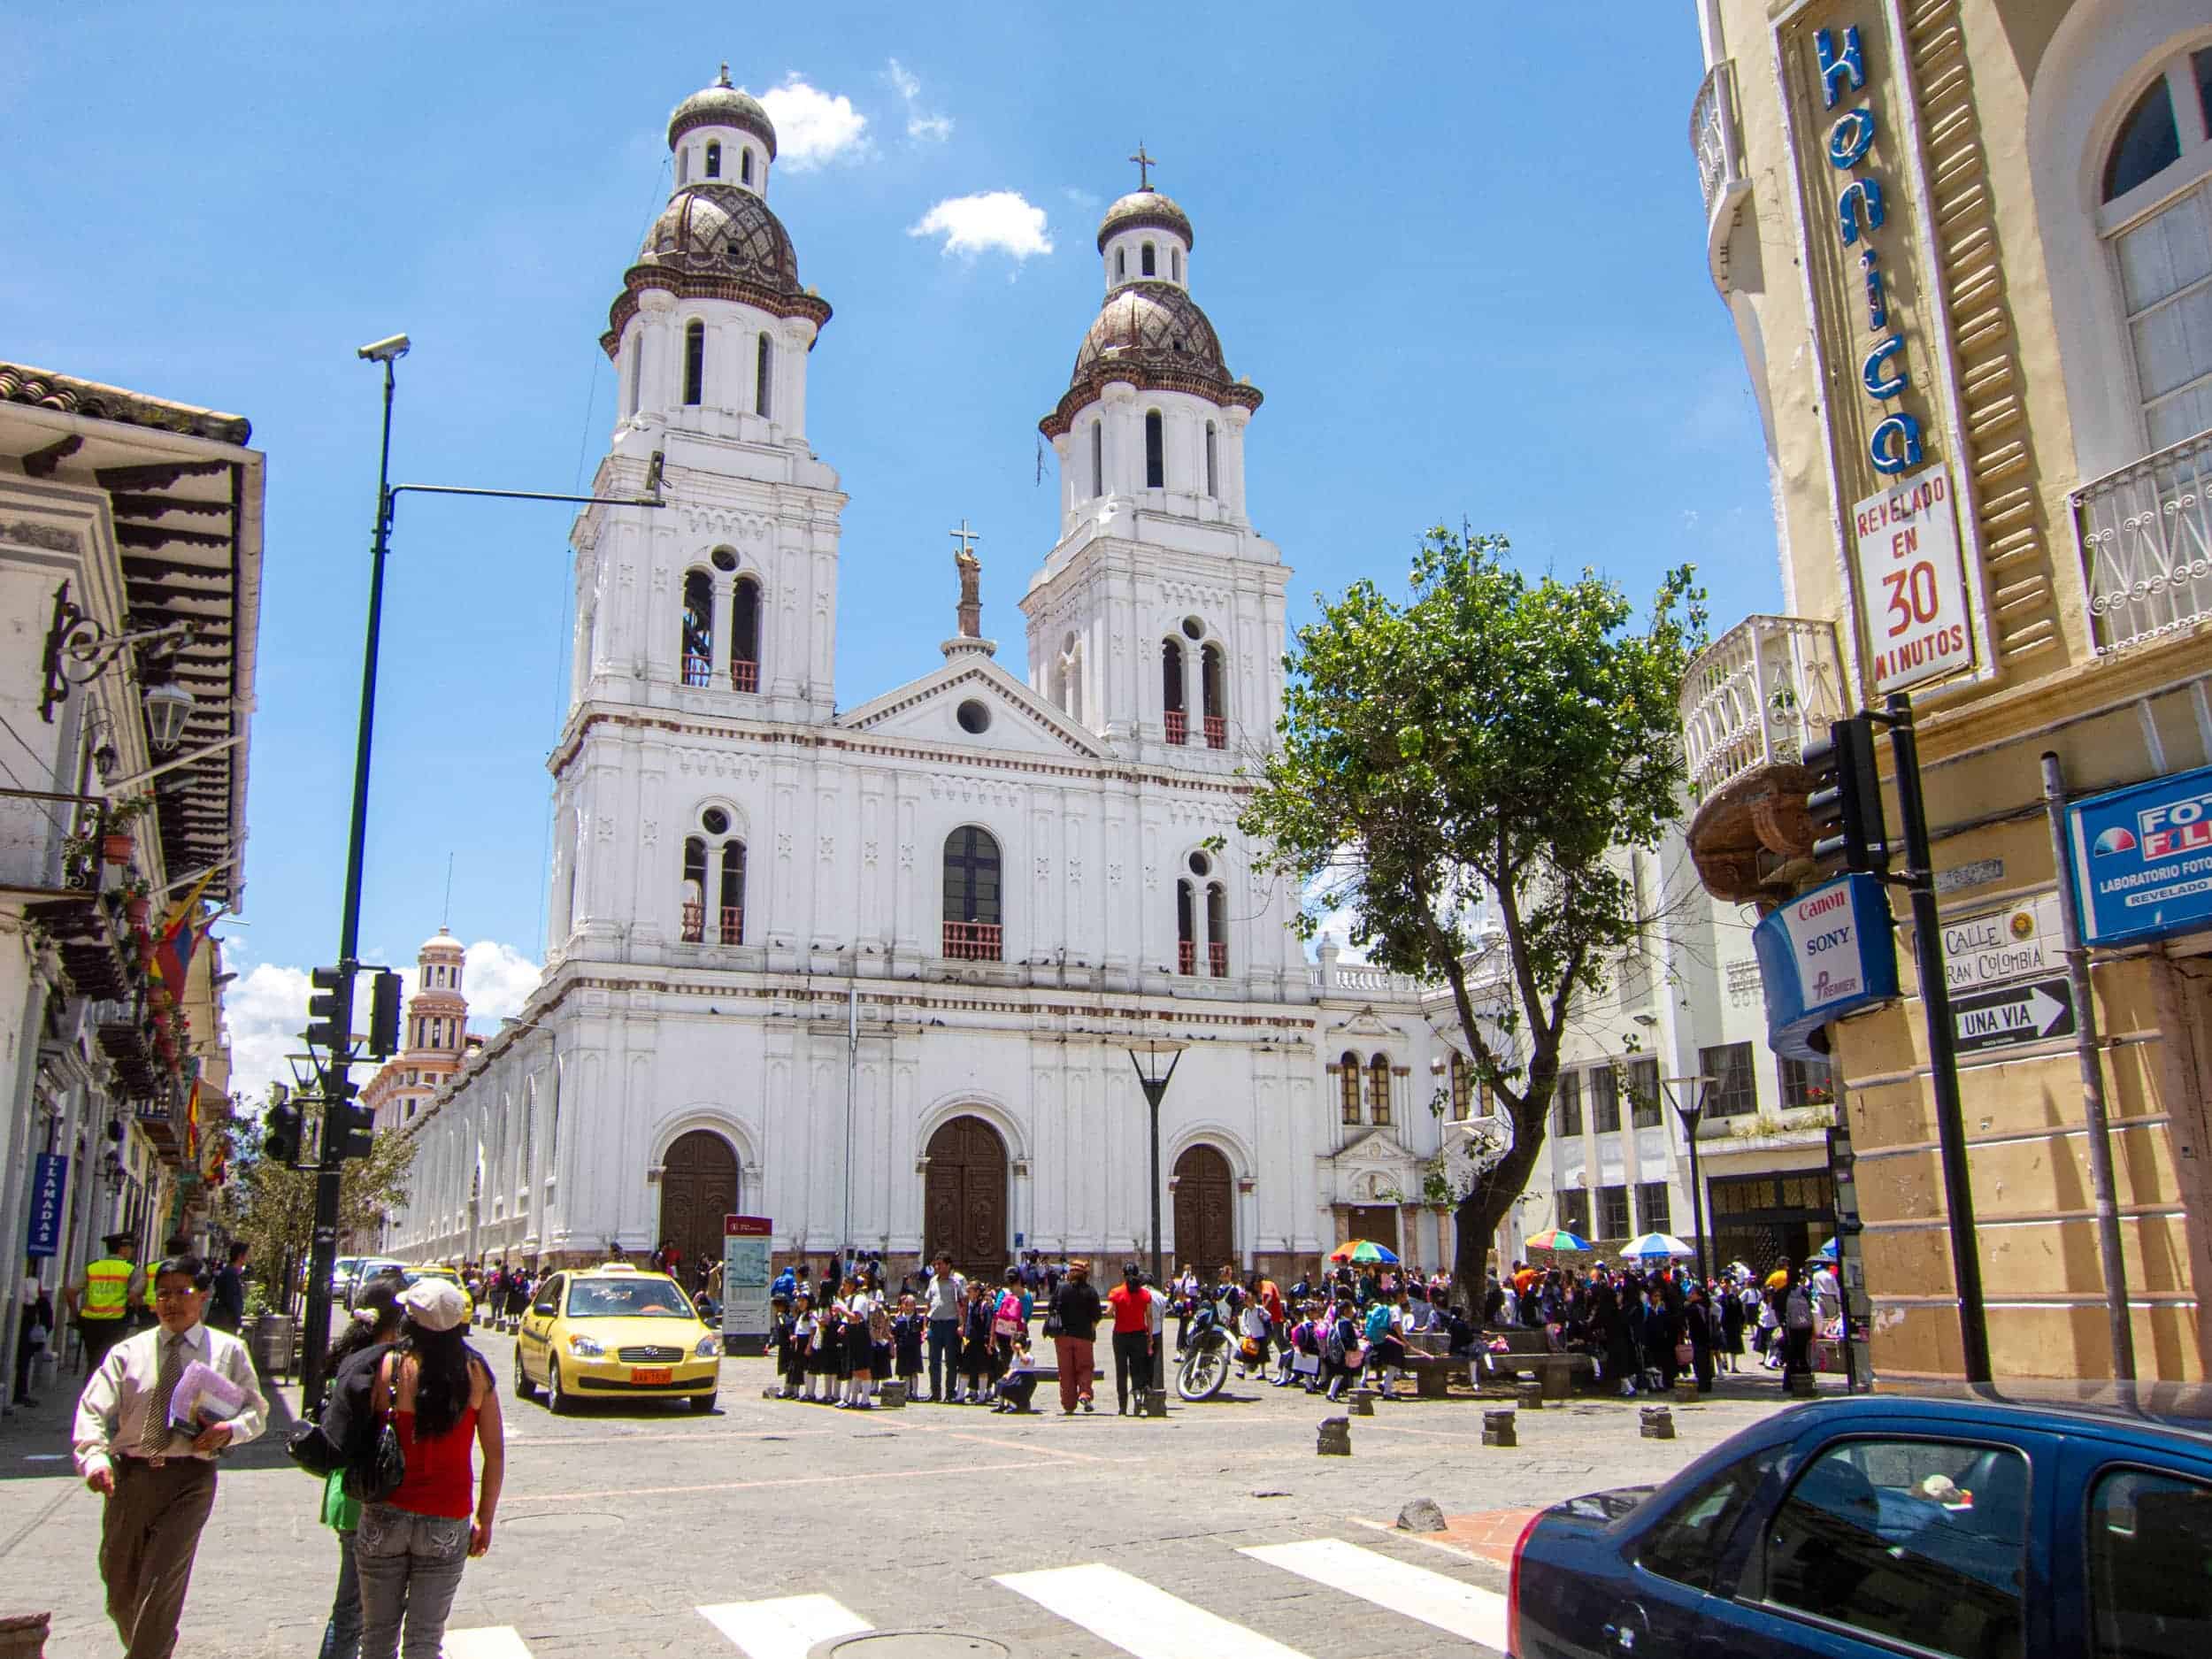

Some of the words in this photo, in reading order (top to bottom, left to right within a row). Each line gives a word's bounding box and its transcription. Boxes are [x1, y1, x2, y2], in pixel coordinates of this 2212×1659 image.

[1857, 476, 1945, 539] REVELADO
[1892, 526, 1918, 559] EN
[1882, 561, 1939, 638] 30
[1875, 624, 1963, 680] MINUTOS
[2144, 820, 2212, 856] FIL
[2100, 864, 2179, 894] LABORATORIO
[2130, 880, 2208, 904] REVELADO
[1798, 890, 1846, 921] Canon
[1806, 926, 1850, 956] SONY
[1946, 925, 2001, 955] CALLE
[1964, 1010, 1999, 1035] UNA
[2001, 1003, 2032, 1027] VIA
[39, 1156, 58, 1242] LLAMADAS
